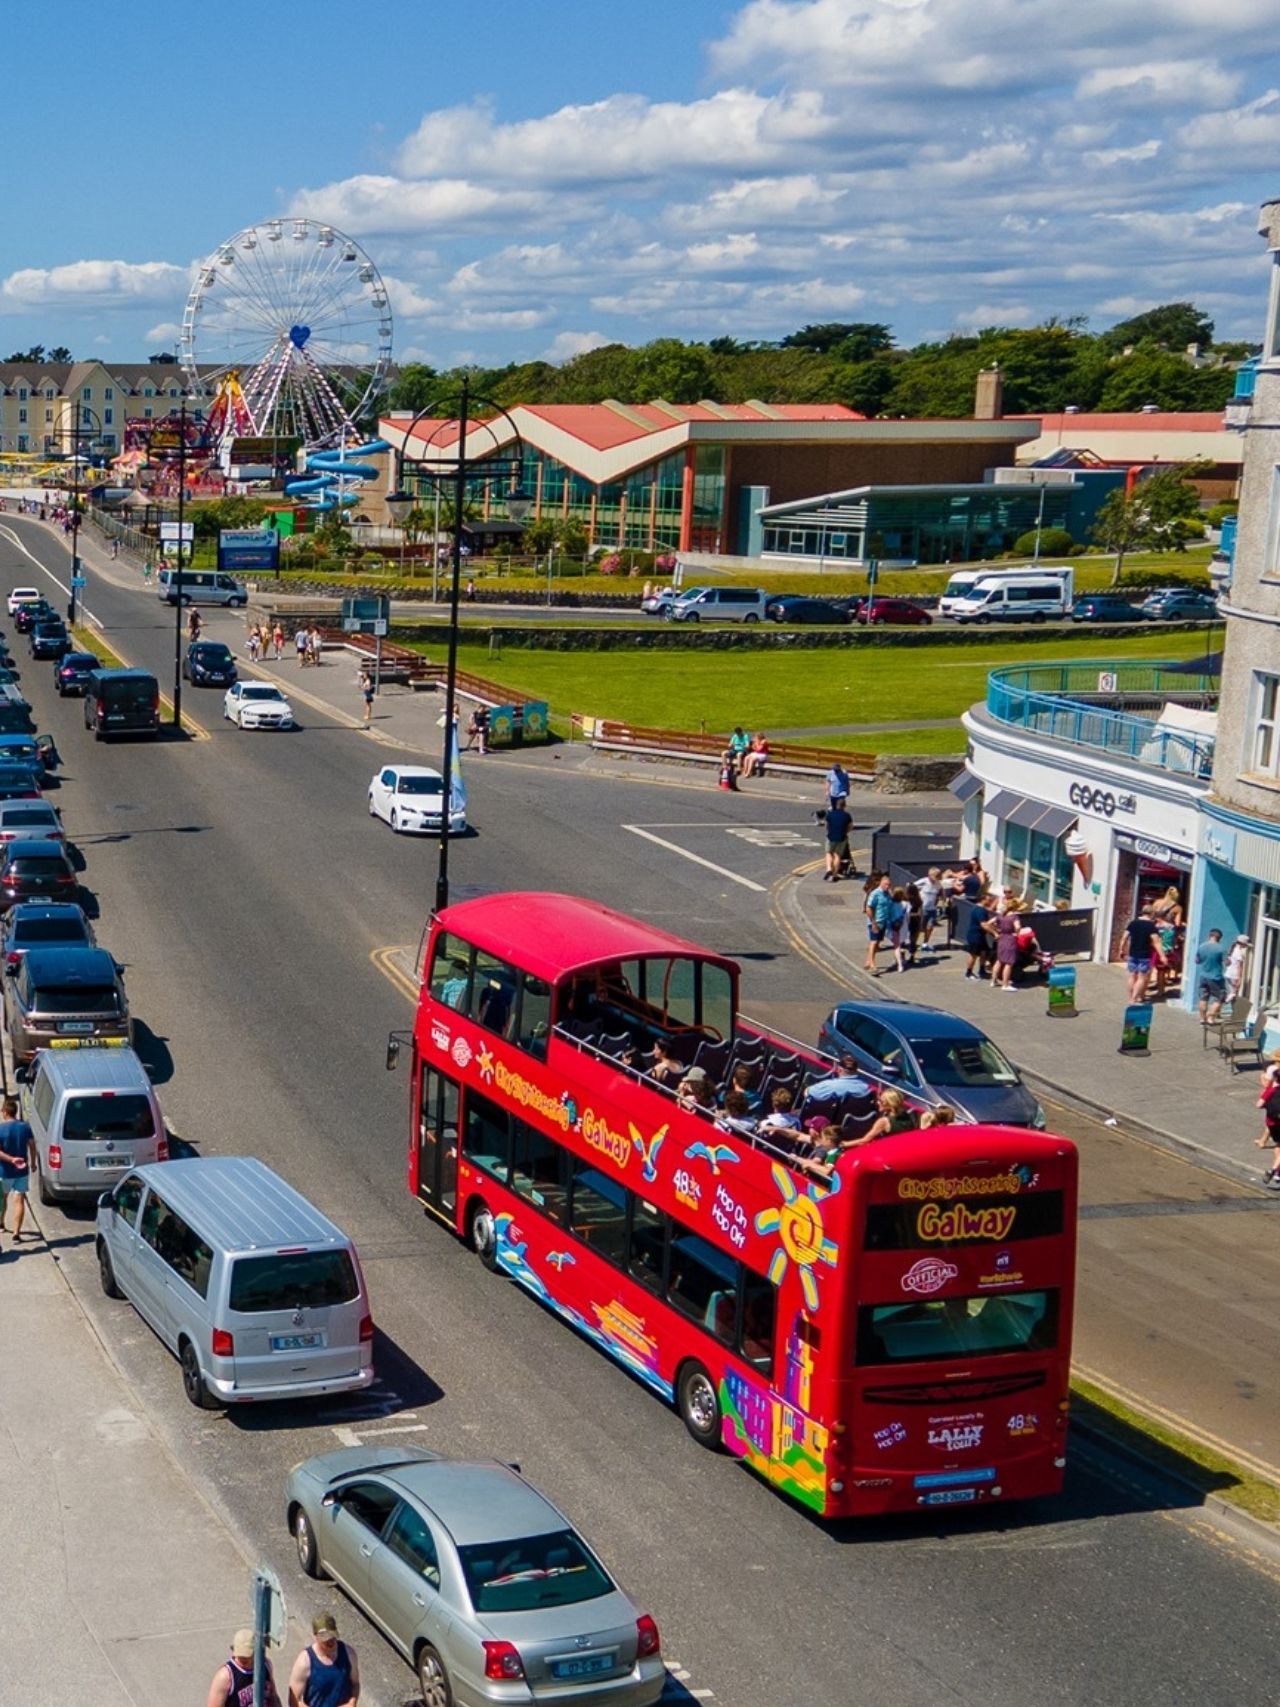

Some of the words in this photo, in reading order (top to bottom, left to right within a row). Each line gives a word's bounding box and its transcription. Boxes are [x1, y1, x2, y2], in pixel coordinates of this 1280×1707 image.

[582, 1107, 631, 1168] Galway
[716, 1184, 734, 1212] Hop
[734, 1205, 748, 1229] On
[917, 1203, 1017, 1241] Galway
[712, 1203, 729, 1231] Hop
[730, 1225, 746, 1249] Off
[906, 1267, 953, 1286] OFFICIAL
[927, 1425, 984, 1444] LALLY
[1007, 1414, 1024, 1429] 48
